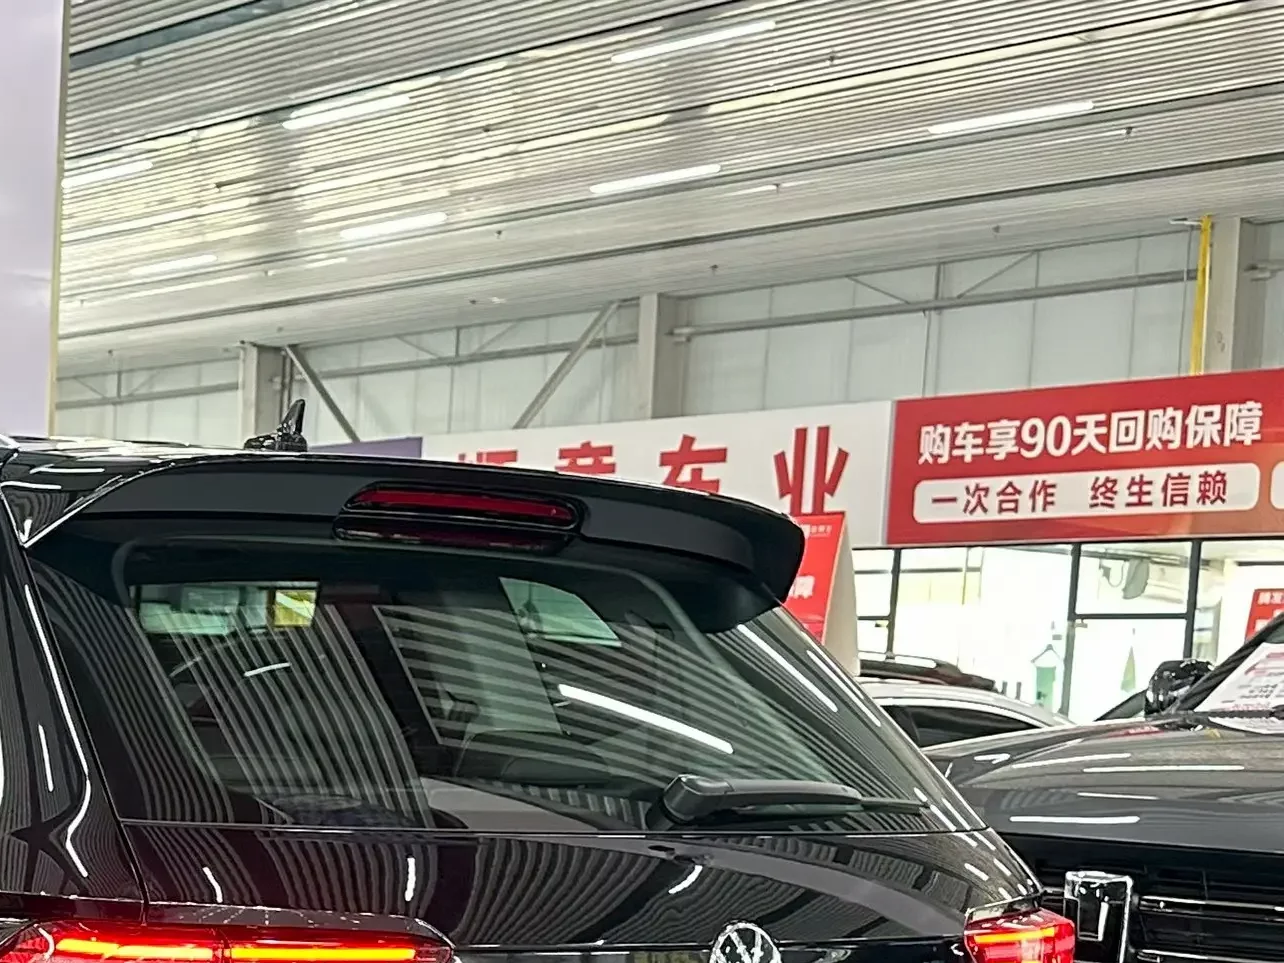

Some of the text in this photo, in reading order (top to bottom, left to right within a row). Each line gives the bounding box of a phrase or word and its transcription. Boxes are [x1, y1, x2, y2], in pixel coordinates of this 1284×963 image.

[918, 401, 1262, 465] 购车享90天回购保障
[931, 470, 1228, 515] 一次合作 终生信赖
